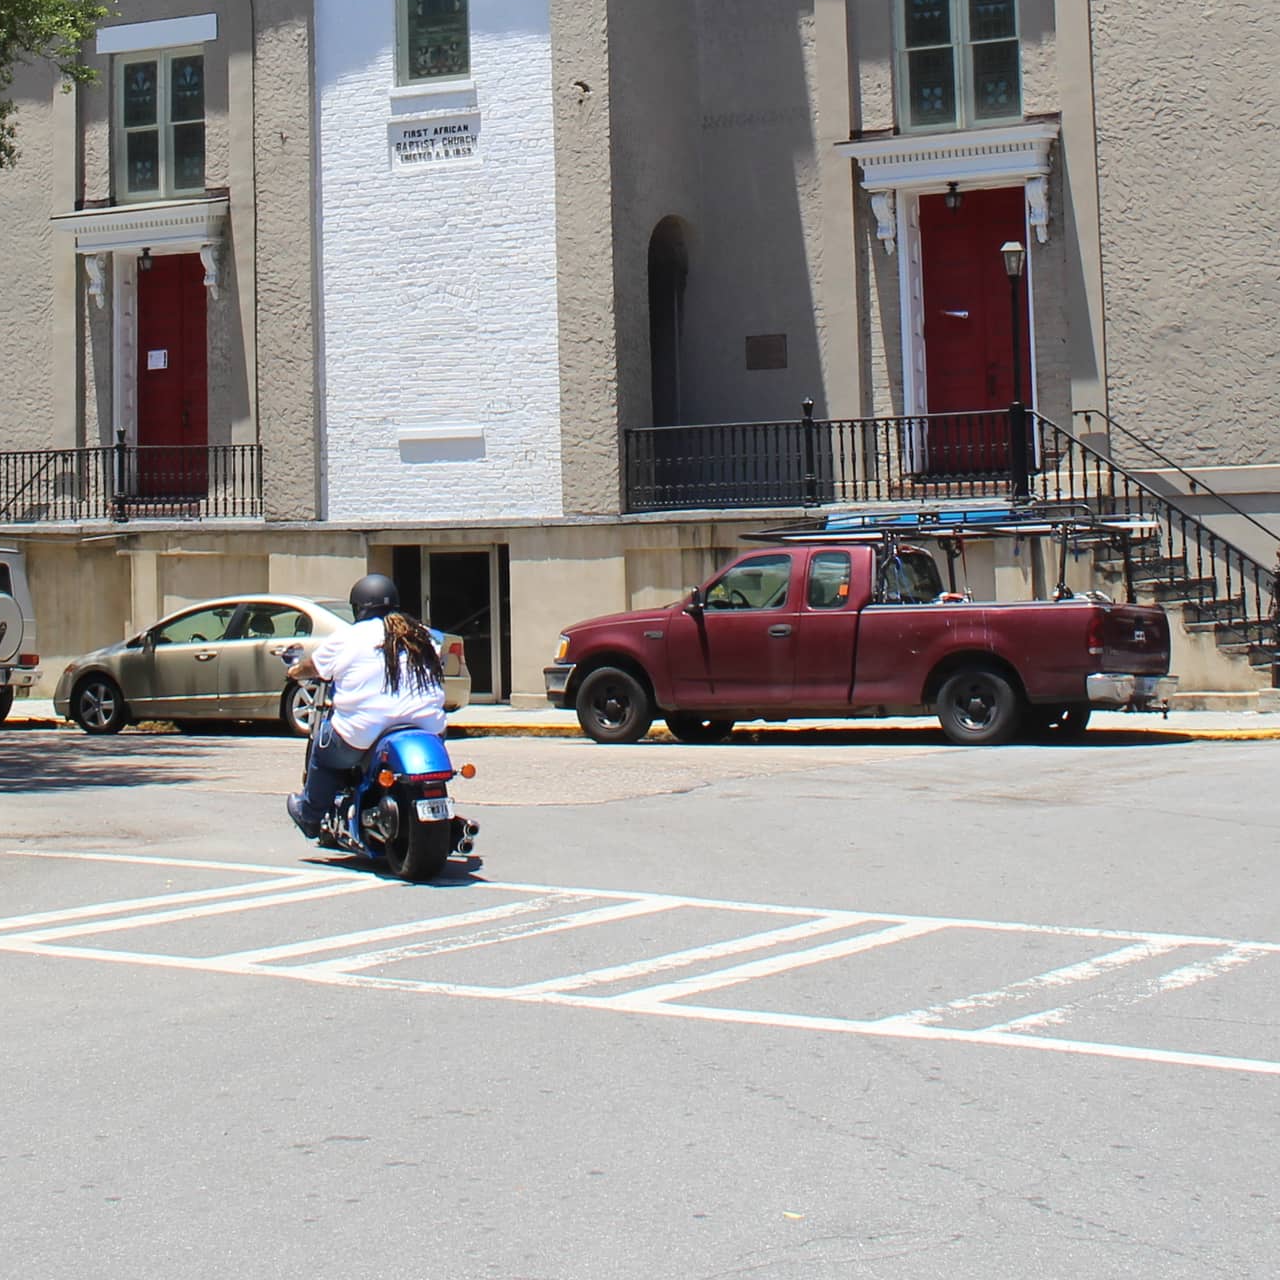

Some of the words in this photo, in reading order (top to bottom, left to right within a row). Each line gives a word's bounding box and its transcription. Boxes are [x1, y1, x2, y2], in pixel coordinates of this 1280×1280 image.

[403, 128, 428, 139] FIRST
[433, 124, 469, 136] AFRICAN
[396, 138, 436, 152] BAPTIST
[442, 135, 478, 147] CHURCH
